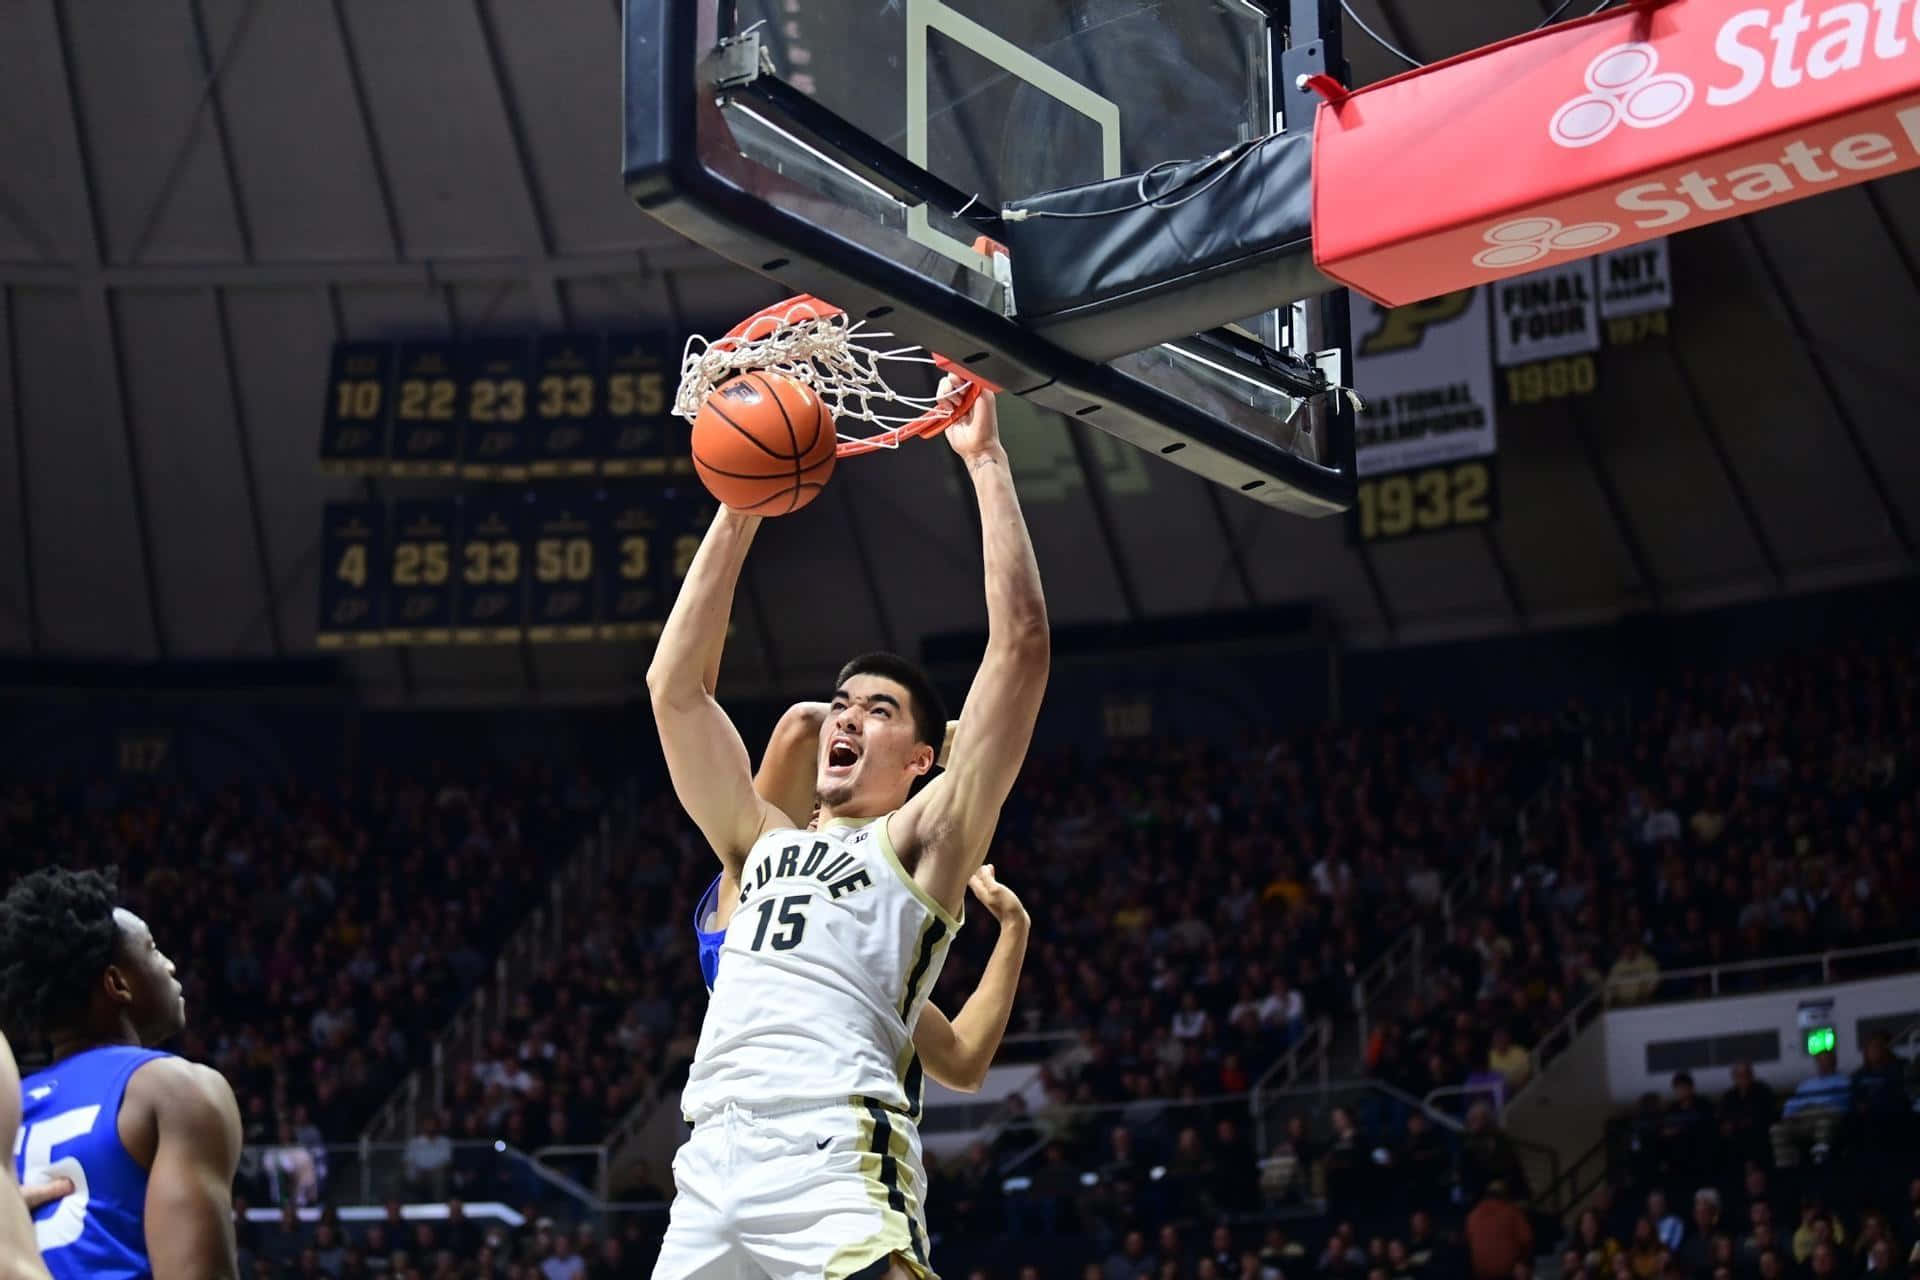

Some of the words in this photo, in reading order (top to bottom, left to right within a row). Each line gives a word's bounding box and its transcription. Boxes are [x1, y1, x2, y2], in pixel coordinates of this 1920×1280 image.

[1707, 0, 1920, 106] Stat
[1609, 251, 1658, 283] NIT
[1503, 272, 1589, 314] FINAL
[1510, 306, 1586, 345] FOUR
[337, 379, 381, 420] 10
[400, 379, 456, 421] 22
[469, 379, 526, 423] 23
[538, 375, 595, 418] 33
[608, 372, 664, 416] 55
[1358, 462, 1490, 541] 1932
[336, 543, 367, 588] 4
[393, 541, 449, 586] 25
[464, 539, 520, 584] 33
[536, 538, 593, 583] 50
[619, 536, 650, 580] 3
[739, 840, 872, 904] PURDUE
[750, 894, 813, 952] 15
